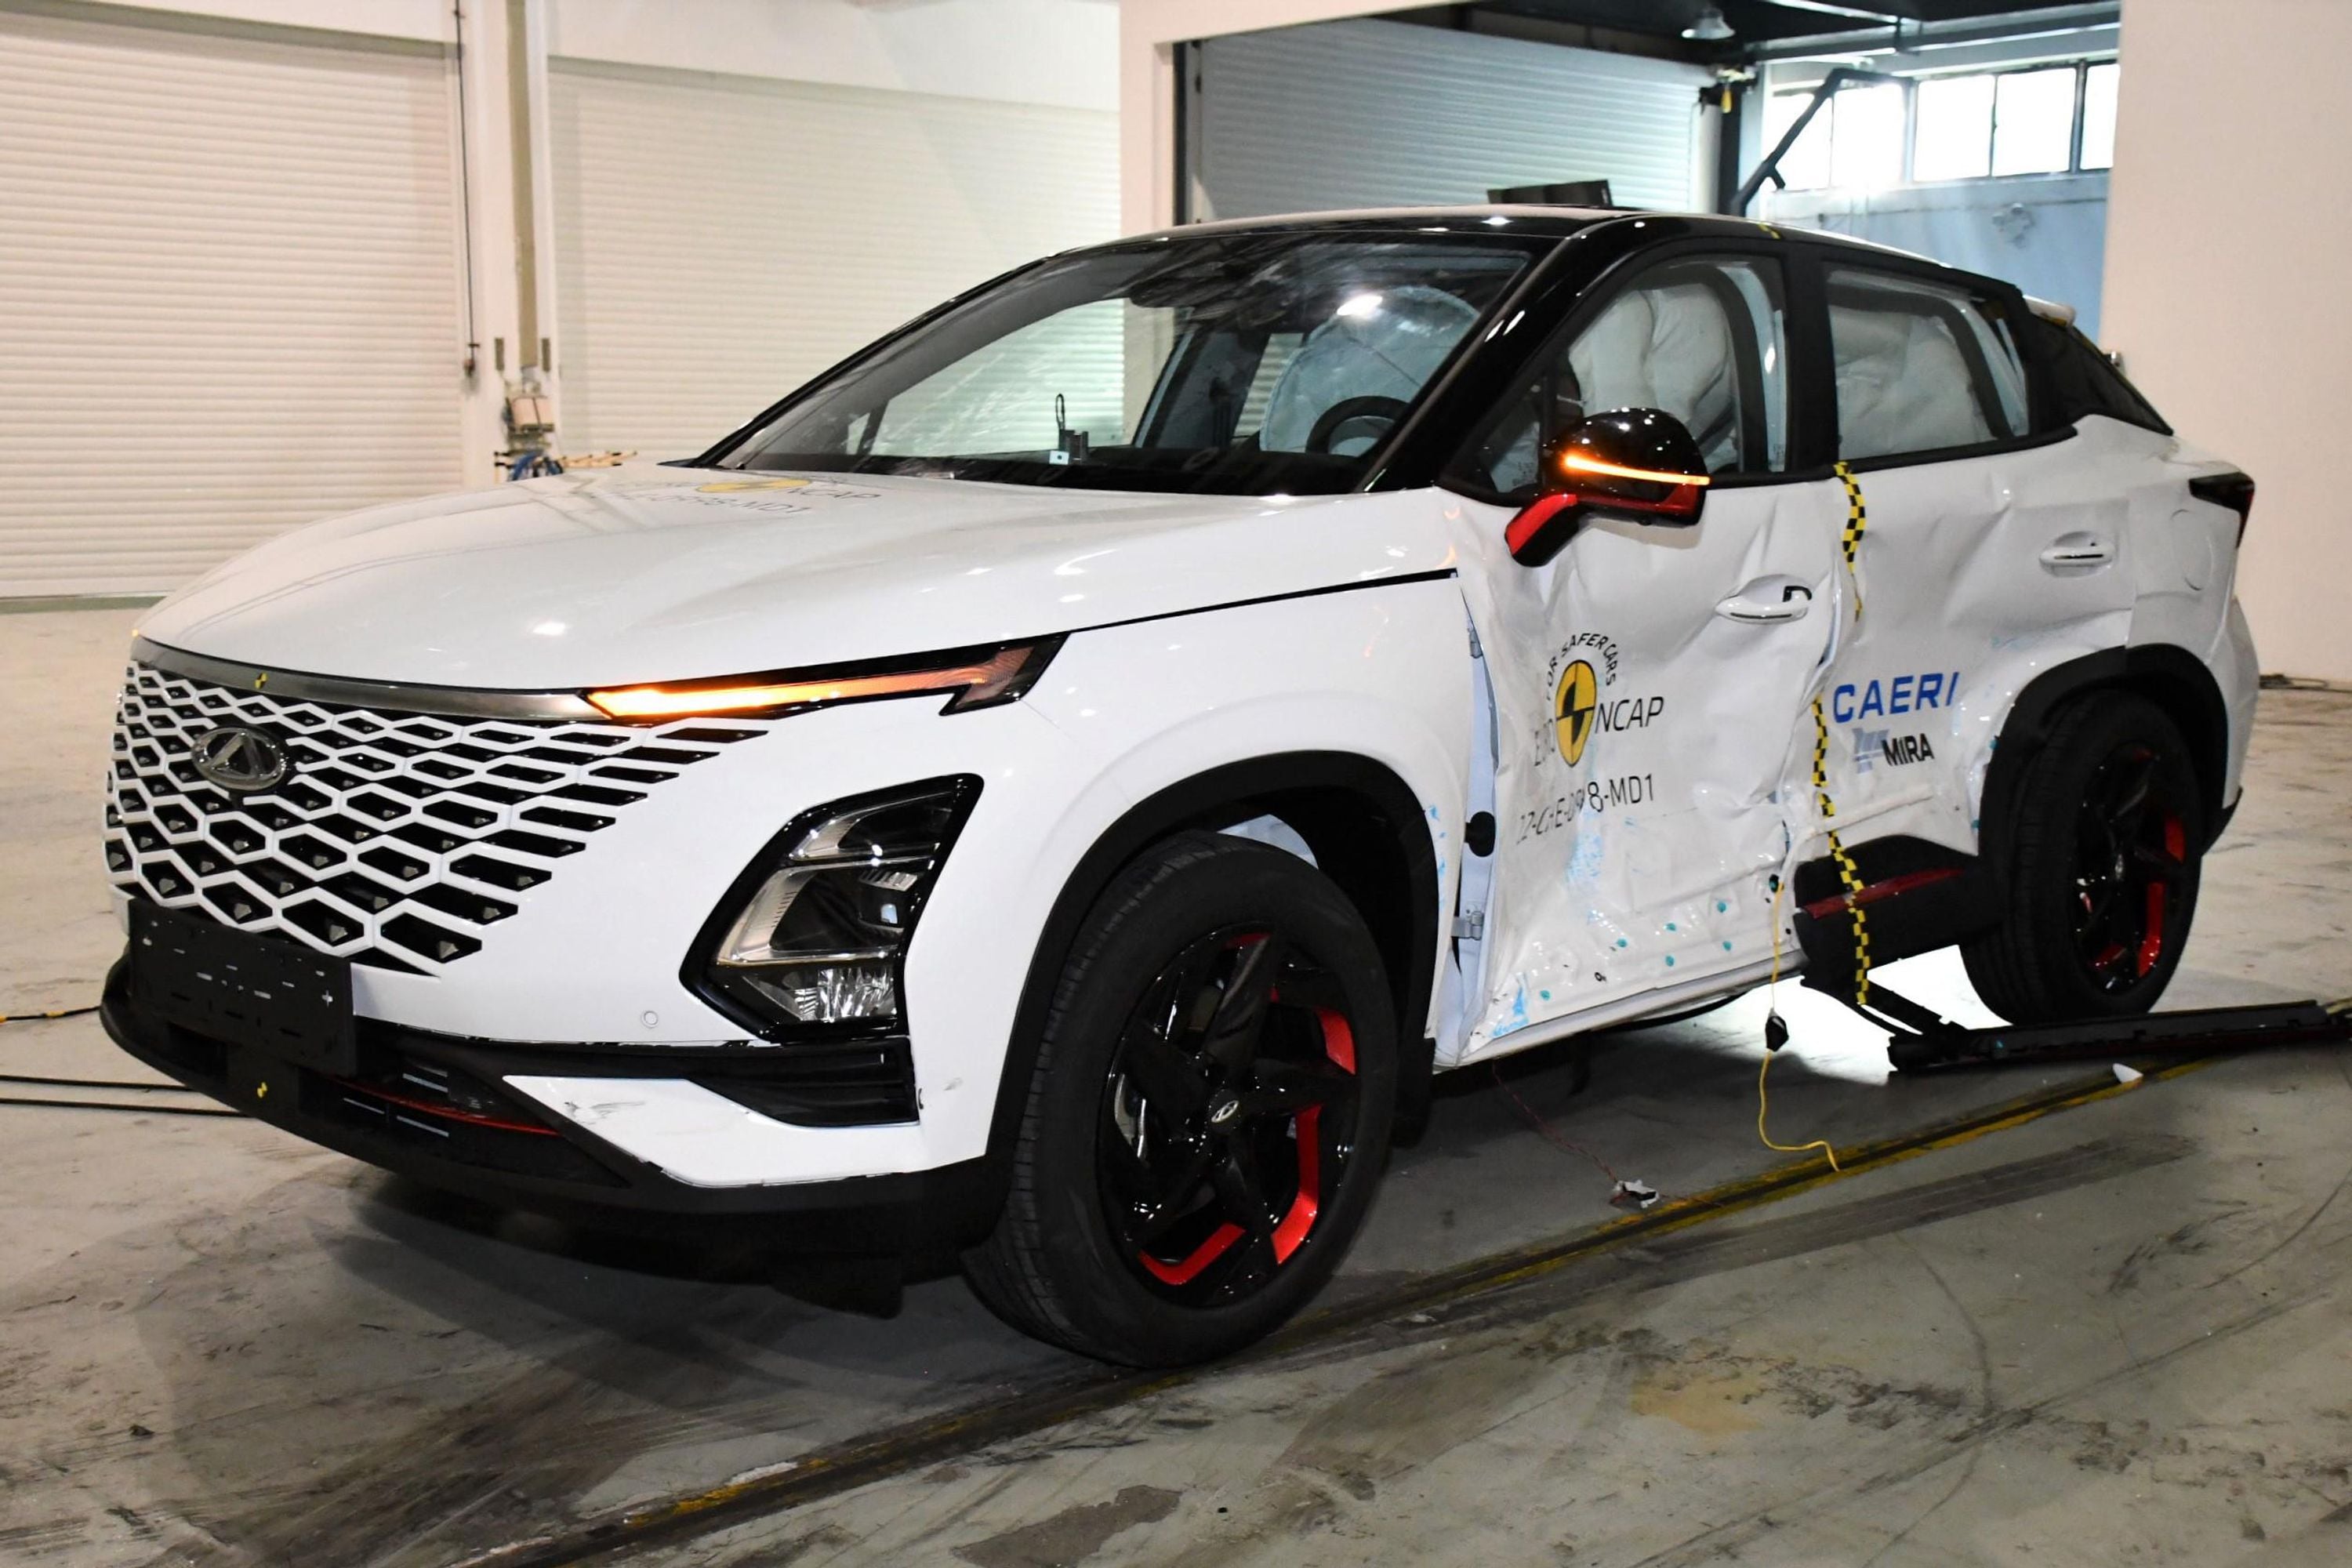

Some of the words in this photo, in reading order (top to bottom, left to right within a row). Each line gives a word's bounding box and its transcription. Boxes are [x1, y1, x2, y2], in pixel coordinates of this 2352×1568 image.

[1561, 632, 1610, 658] SAFER
[1602, 643, 1619, 687] CARS
[1595, 695, 1664, 735] NCAP
[1833, 671, 1960, 724] CAERI
[1882, 732, 1935, 767] MIRA
